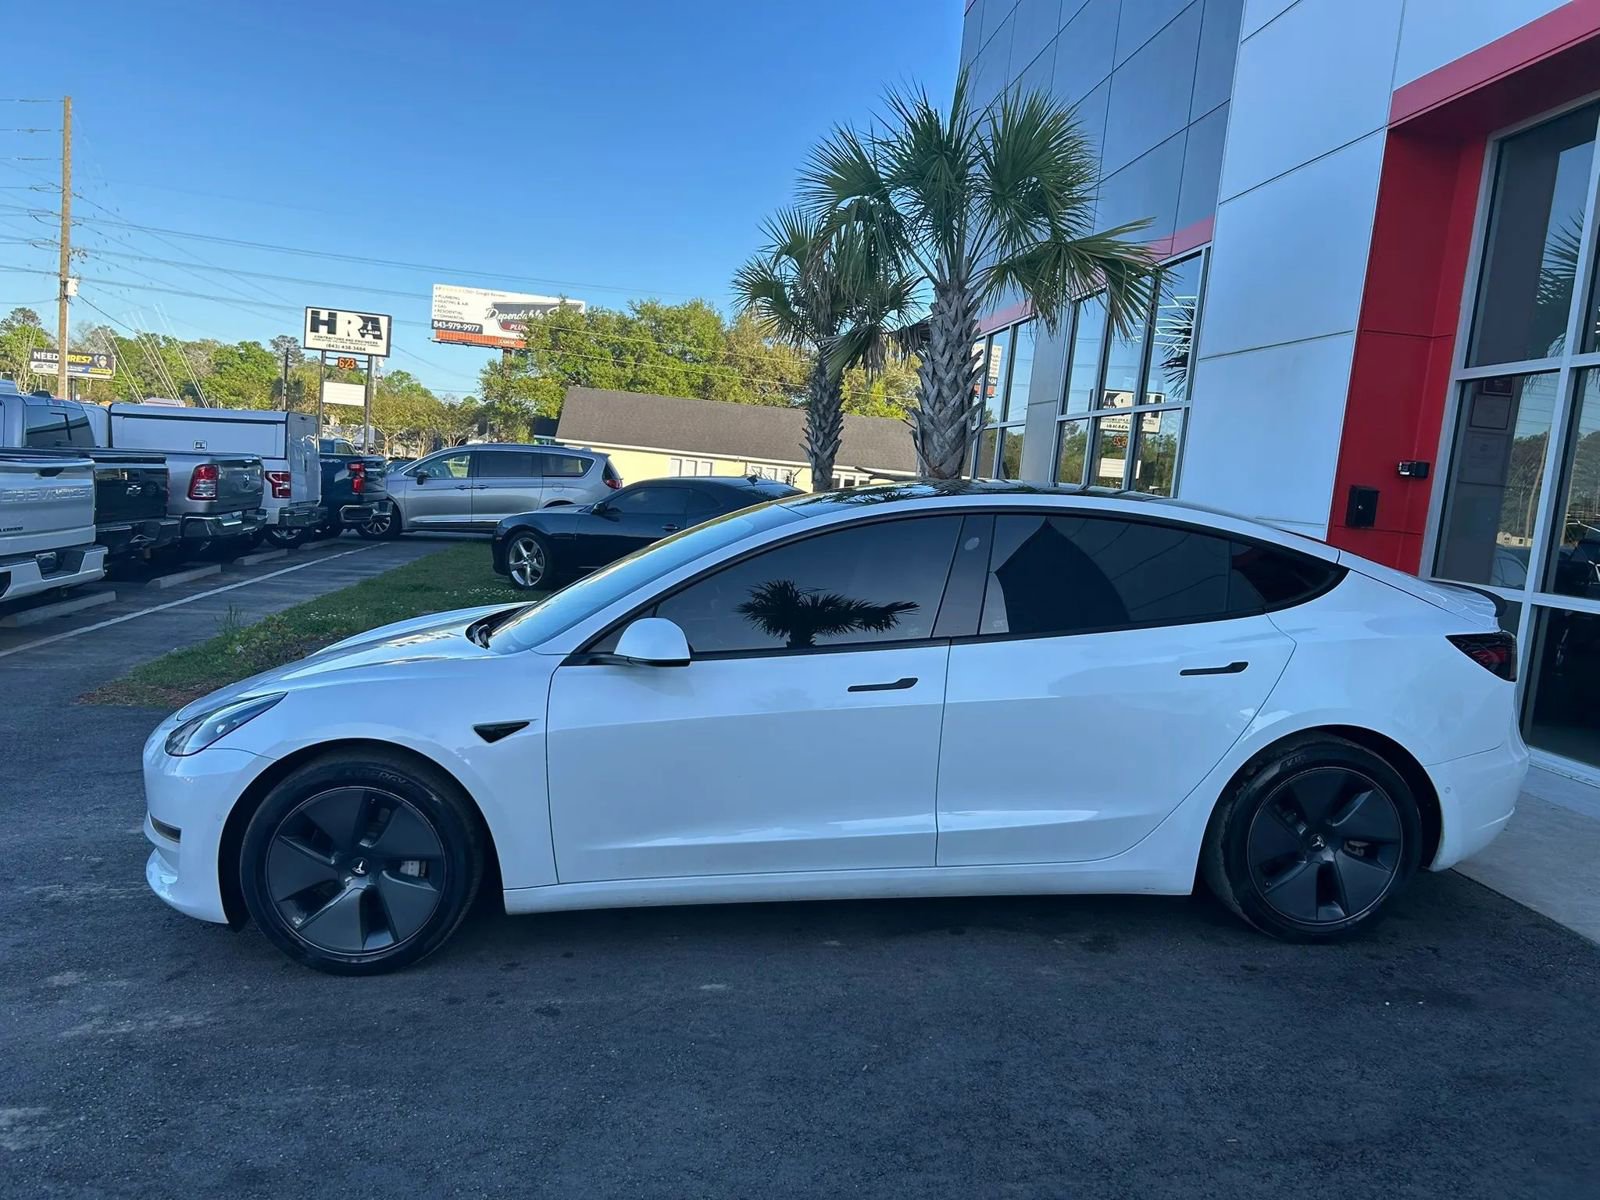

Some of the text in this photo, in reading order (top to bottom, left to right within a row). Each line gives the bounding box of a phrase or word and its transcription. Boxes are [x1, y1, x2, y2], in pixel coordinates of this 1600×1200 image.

[310, 310, 383, 340] HRA
[433, 320, 480, 332] 843-979-9977
[33, 352, 59, 360] NEED
[66, 355, 92, 364] IRES?
